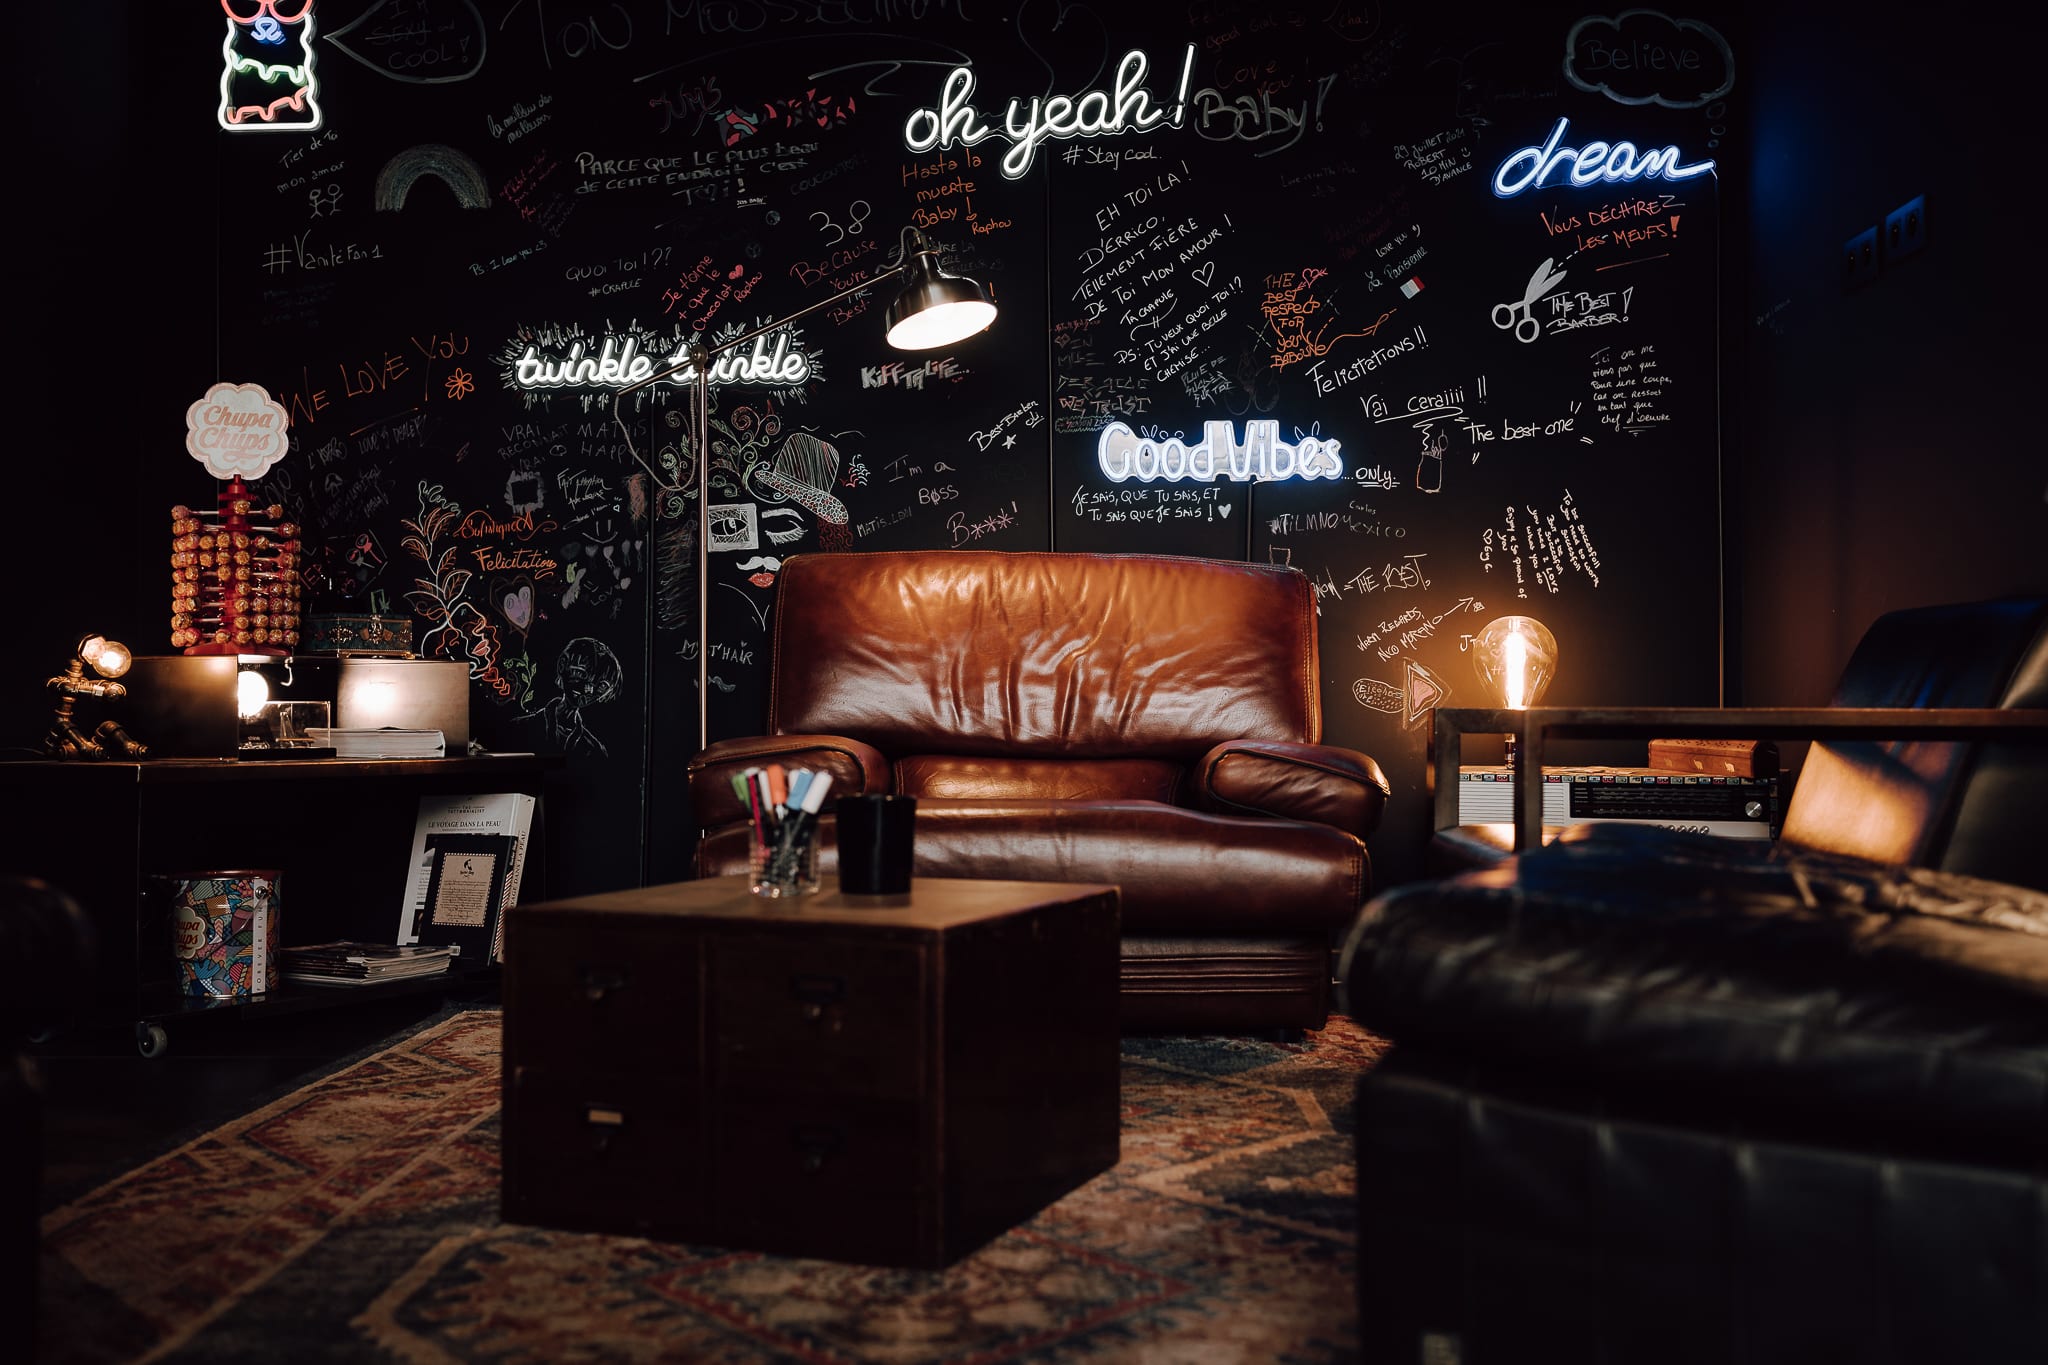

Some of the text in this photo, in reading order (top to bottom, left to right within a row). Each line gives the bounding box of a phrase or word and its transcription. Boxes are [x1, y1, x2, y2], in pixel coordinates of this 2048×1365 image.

[1581, 39, 1701, 71] Believe
[905, 67, 990, 152] oh
[575, 151, 640, 175] PARCE
[644, 157, 683, 172] QUE
[693, 151, 718, 166] LE
[725, 147, 768, 163] PLUS
[902, 149, 983, 187] Hasta la
[1492, 116, 1717, 198] dream
[277, 177, 305, 192] mon
[809, 200, 870, 247] 38
[1096, 203, 1121, 231] EH
[1577, 234, 1605, 252] LES
[1084, 299, 1108, 321] DE
[1142, 262, 1174, 287] MON
[1264, 272, 1296, 289] THE
[662, 288, 684, 314] Je
[1144, 308, 1228, 371] ET UNE BELLE
[1144, 338, 1163, 354] TU
[513, 336, 652, 386] twinkle
[280, 366, 330, 428] WE
[339, 352, 409, 398] LOVE
[203, 405, 275, 432] Chupa
[1501, 418, 1541, 440] best
[200, 427, 270, 451] Chups
[883, 455, 956, 483] I'm a
[1120, 488, 1220, 502] QUE TU ET
[1129, 508, 1154, 520] QUE
[1347, 567, 1380, 594] THE
